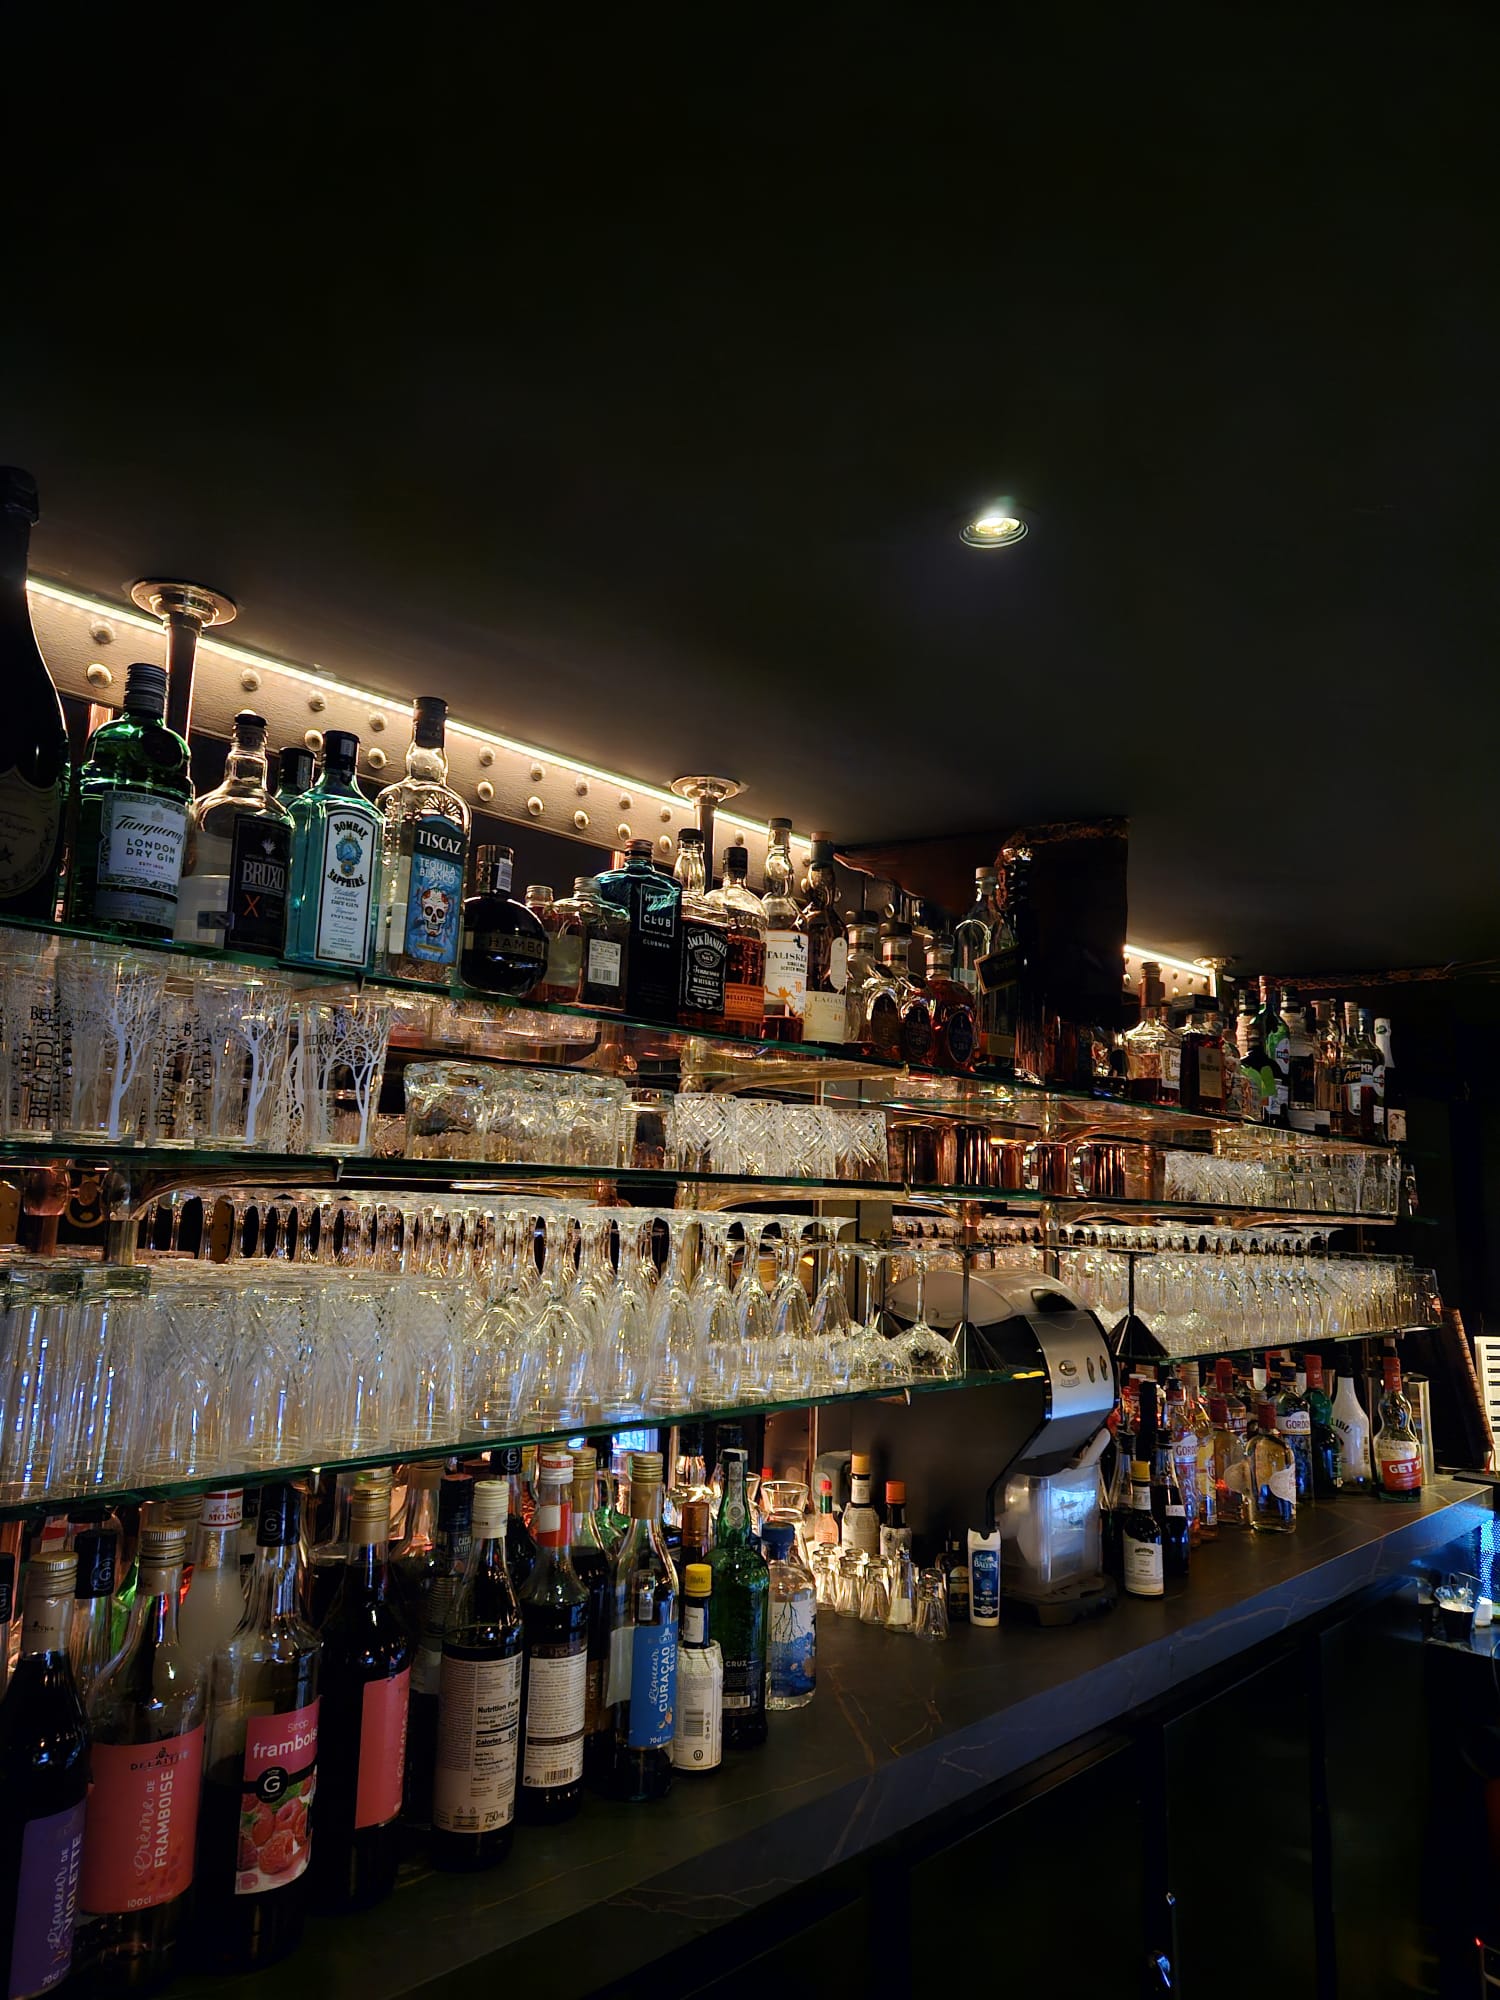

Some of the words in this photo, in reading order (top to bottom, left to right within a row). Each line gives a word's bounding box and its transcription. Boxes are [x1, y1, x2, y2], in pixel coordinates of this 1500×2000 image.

[116, 815, 183, 845] Tanqueray
[333, 820, 369, 841] BOMBAY
[127, 838, 176, 855] LONDON
[418, 829, 462, 855] TISCAZ
[126, 848, 152, 859] DRY
[157, 853, 175, 864] GIN
[242, 859, 286, 889] BRUXO
[419, 867, 455, 885] BLANCO
[420, 858, 456, 877] TEQUILA
[327, 868, 368, 889] SAPPHIRE
[243, 893, 261, 918] X
[643, 914, 673, 929] CLUB
[687, 931, 706, 950] JACK
[704, 931, 728, 958] DANIEL'S
[767, 950, 808, 963] TALISKE
[692, 977, 720, 988] WHISKEY
[1388, 1462, 1413, 1474] GET
[208, 1511, 241, 1521] MONIN
[264, 1518, 279, 1533] G
[973, 1559, 998, 1569] BALEIN
[650, 1648, 660, 1706] Liqueur
[659, 1646, 671, 1713] CURAÇAO
[478, 1702, 507, 1714] Nutrition
[287, 1720, 310, 1733] Sirop
[252, 1728, 319, 1760] frambois
[475, 1737, 502, 1747] Calories
[649, 1736, 662, 1745] 70cl
[263, 1775, 281, 1793] G
[133, 1797, 155, 1877] Crème
[147, 1779, 156, 1793] DE
[153, 1769, 175, 1870] FRAMBOISE
[61, 1848, 70, 1862] DE
[63, 1832, 82, 1932] VIOLETTE
[127, 1895, 152, 1909] 100cl
